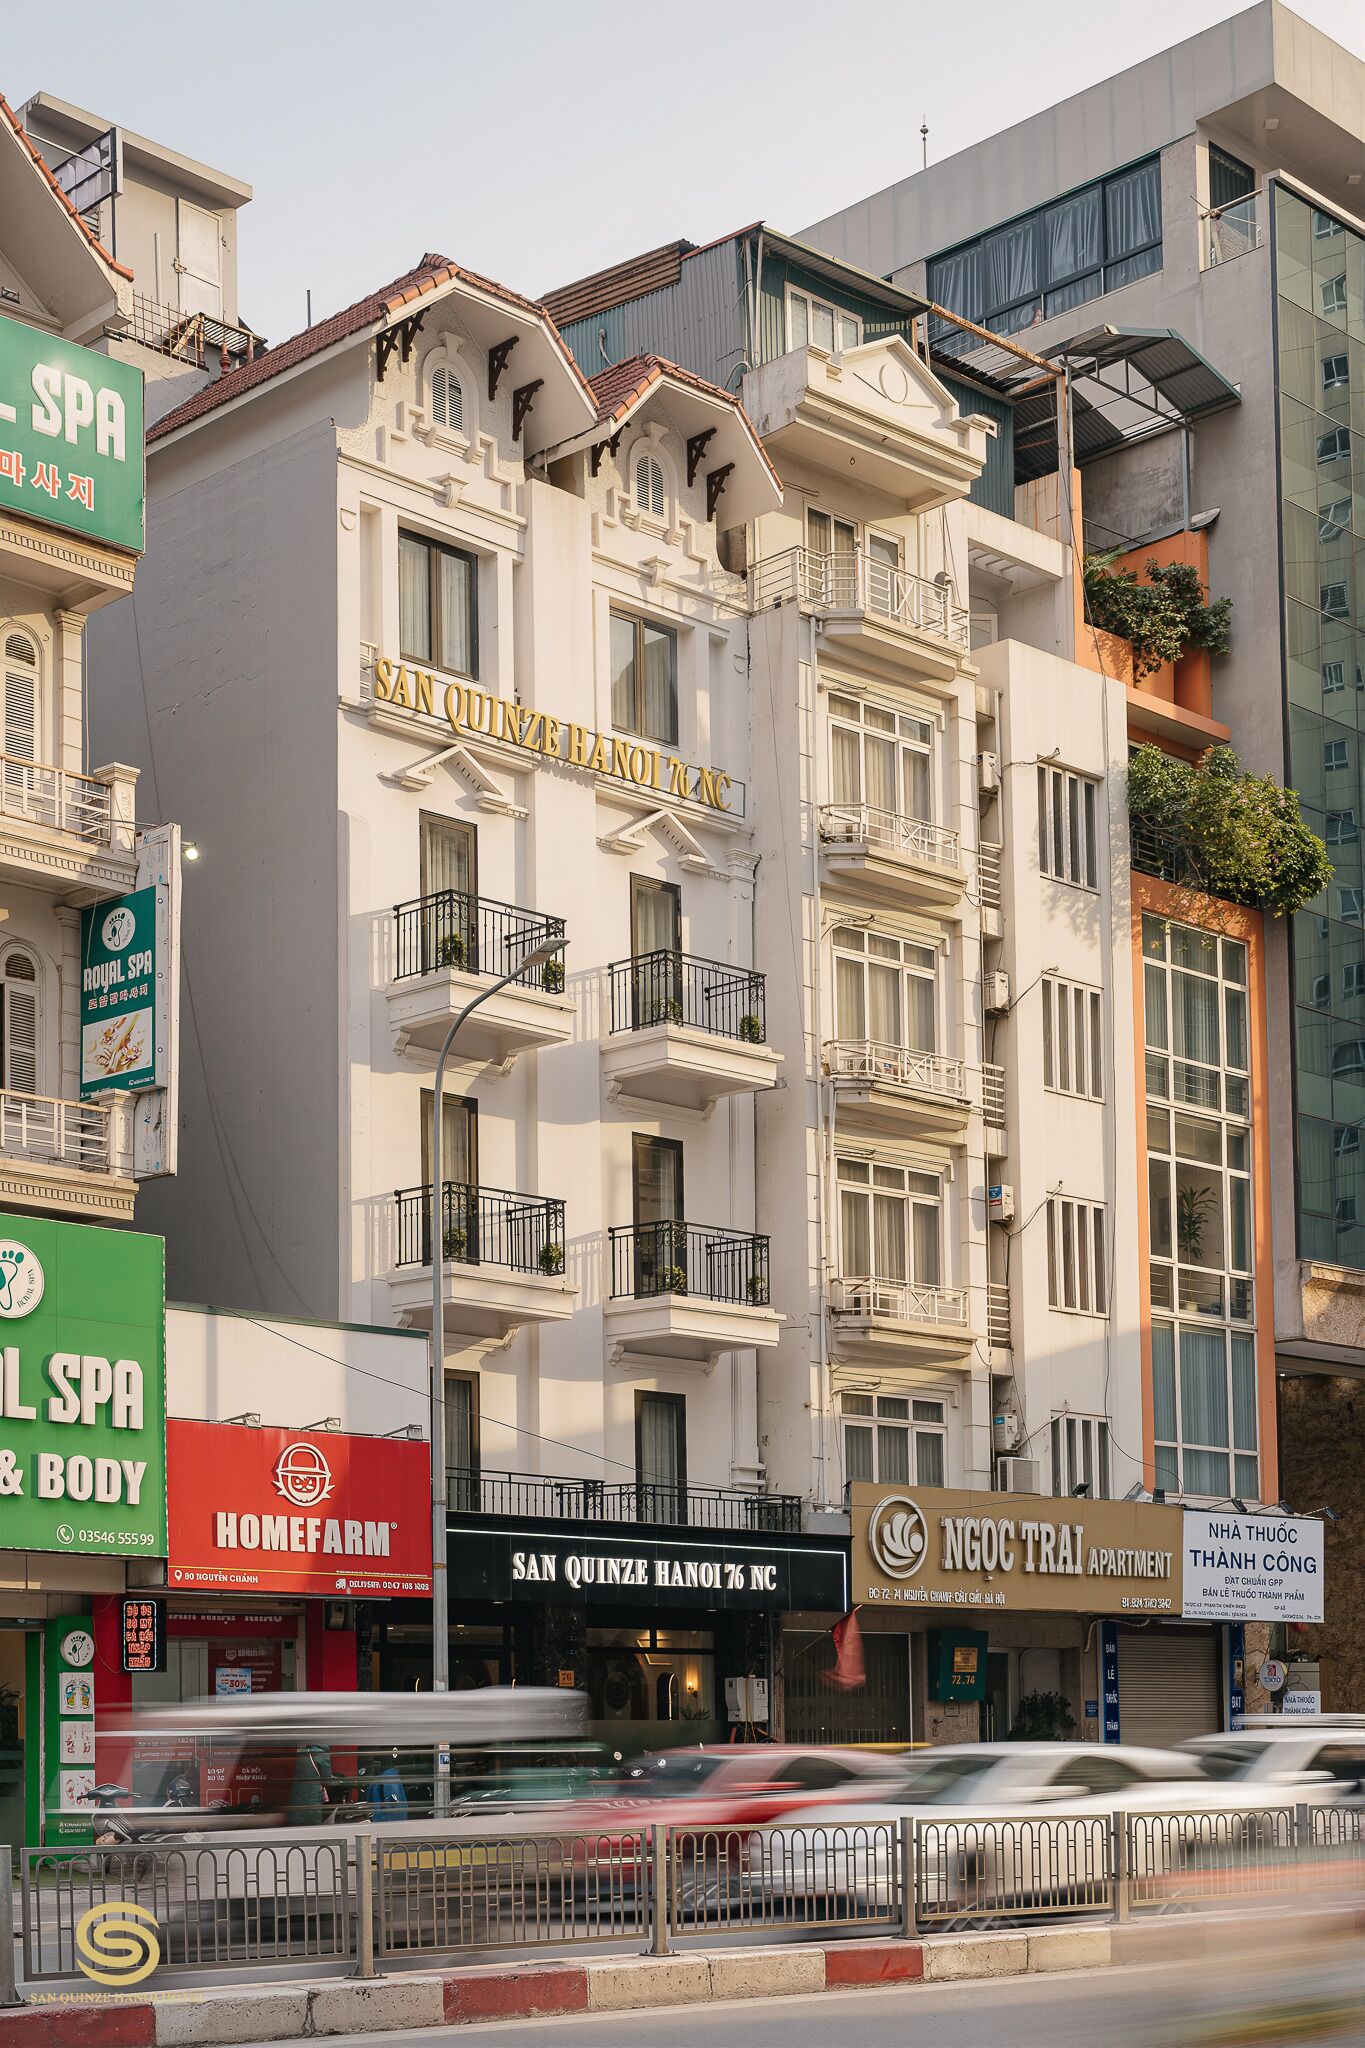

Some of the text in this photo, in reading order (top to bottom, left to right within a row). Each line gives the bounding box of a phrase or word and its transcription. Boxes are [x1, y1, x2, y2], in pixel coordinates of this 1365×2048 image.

[31, 363, 126, 462] SPA
[375, 656, 732, 811] SAN QUINZE HANOI 76 NC
[83, 950, 152, 994] ROYAL SPA
[0, 1347, 144, 1430] L SPA
[37, 1453, 147, 1505] BODY
[79, 1530, 115, 1544] 03546
[1209, 1520, 1298, 1543] NHÀ THUỐC
[940, 1516, 1173, 1581] NGỌC TRAI APARTMENT
[1189, 1546, 1317, 1574] THÀNH CÔNG
[229, 1573, 258, 1583] CHÁNH
[512, 1552, 777, 1591] SAN QUINZE HANOI 76 NC
[1268, 1578, 1283, 1586] GPP
[1203, 1587, 1218, 1597] BÁN
[561, 1672, 572, 1682] 76
